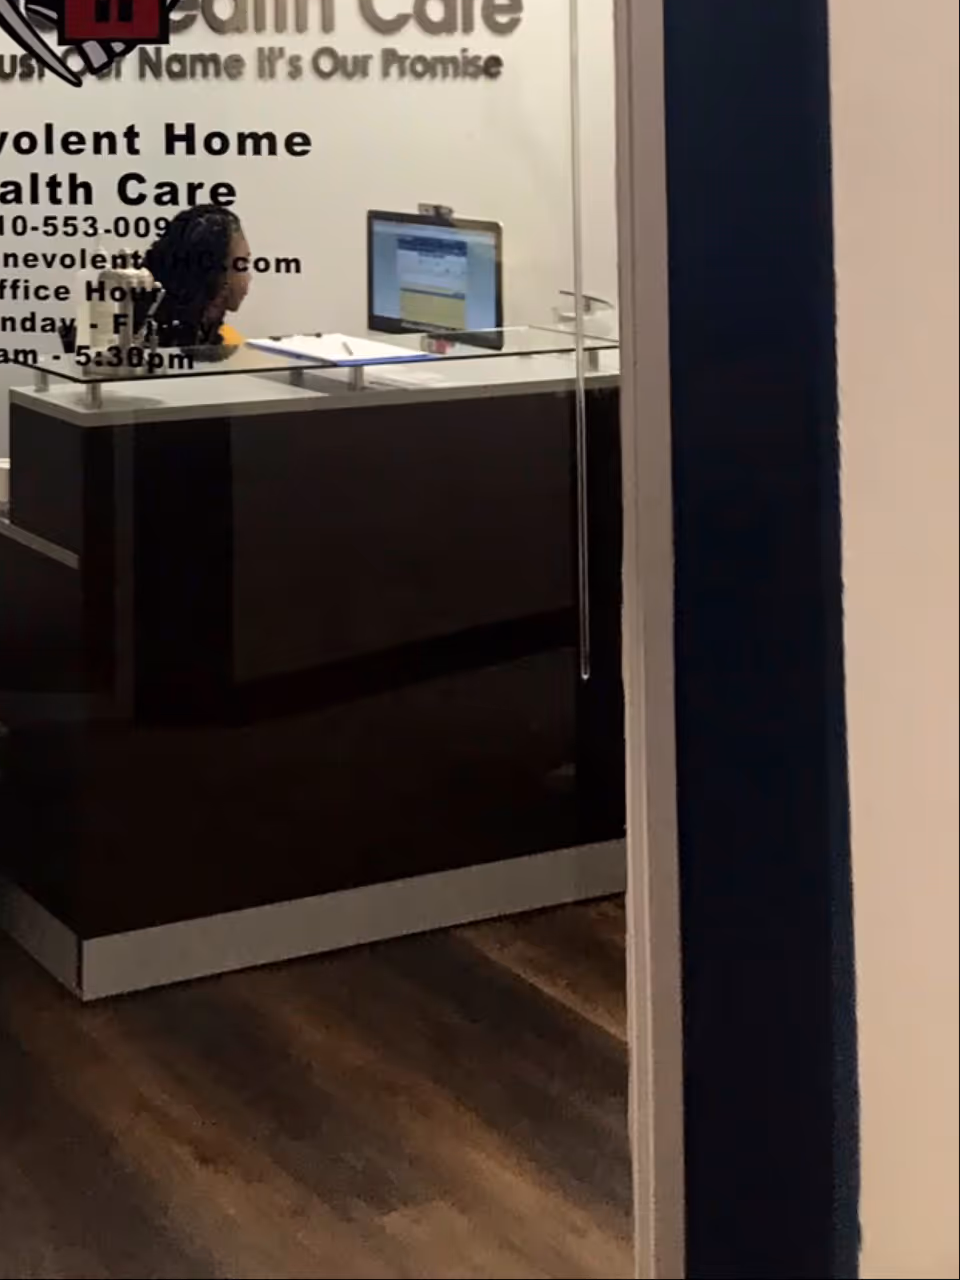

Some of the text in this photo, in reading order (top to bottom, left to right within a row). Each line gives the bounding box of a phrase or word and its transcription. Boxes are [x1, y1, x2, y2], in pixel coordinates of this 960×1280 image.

[138, 46, 245, 81] Name
[256, 47, 302, 80] It's
[312, 48, 373, 80] Our
[381, 48, 504, 81] Promise
[164, 122, 313, 157] Home
[117, 173, 238, 207] Care
[86, 281, 185, 304] Hour
[75, 345, 195, 373] 5:30pm
